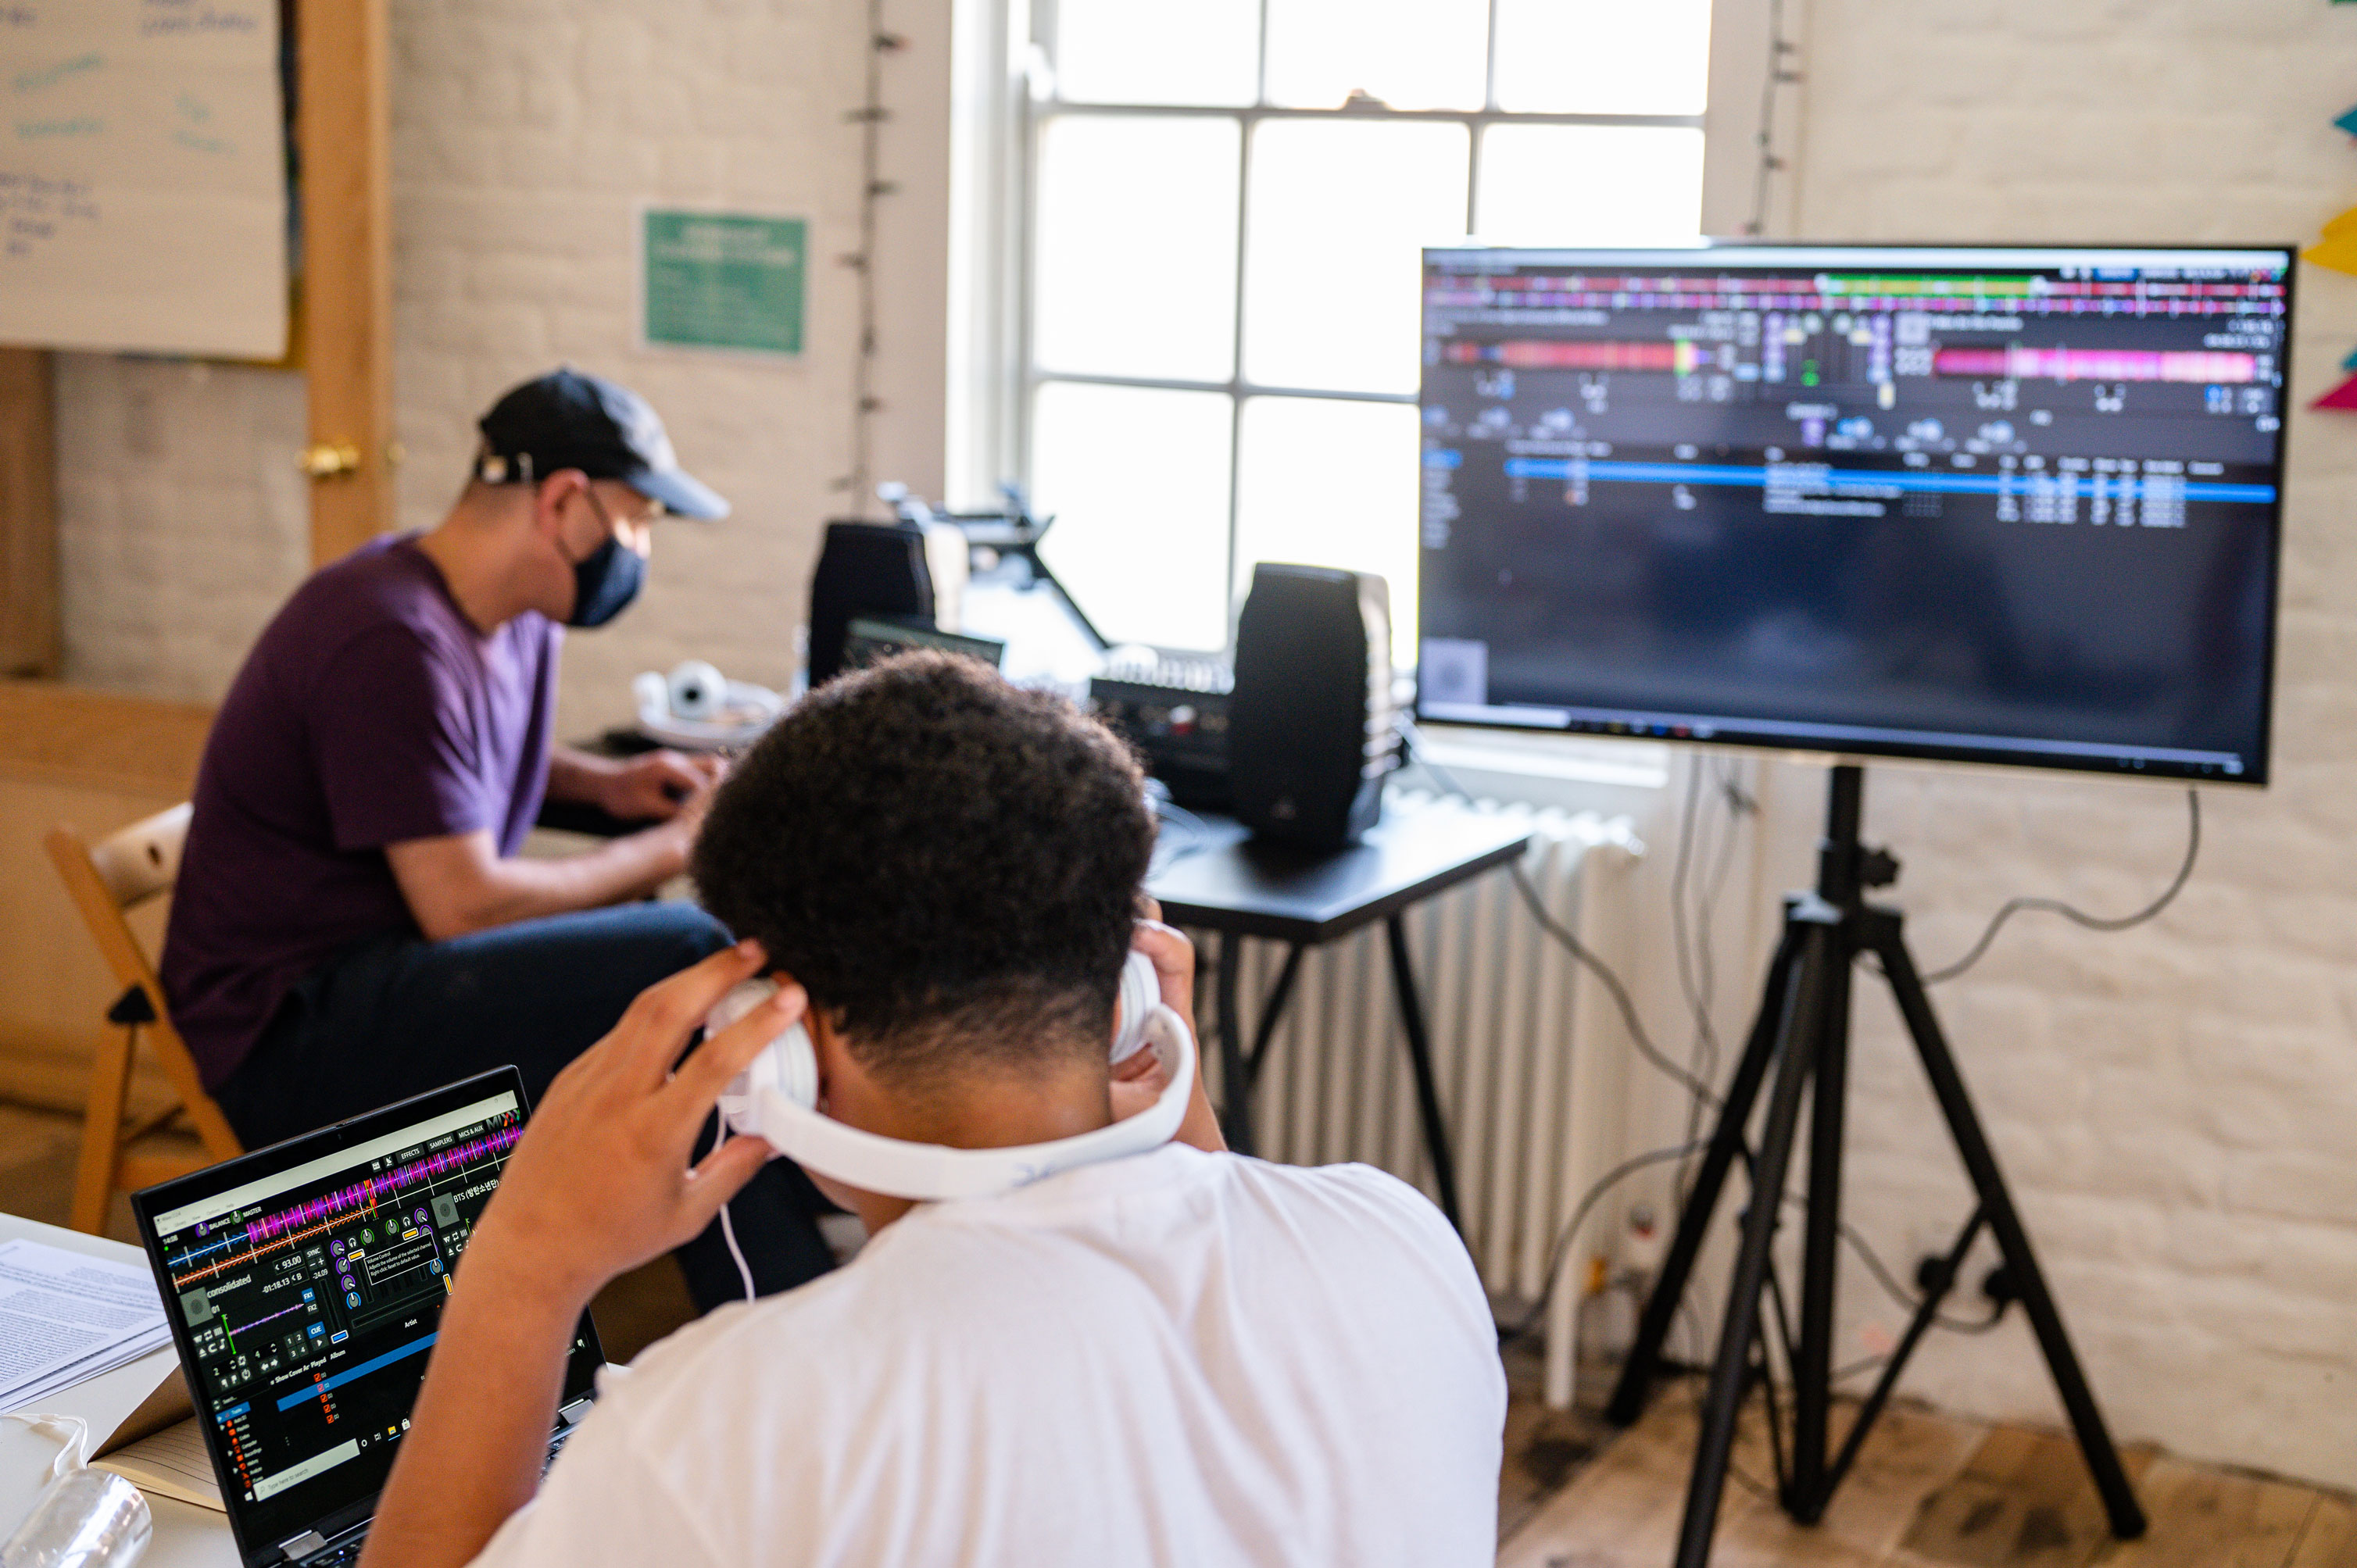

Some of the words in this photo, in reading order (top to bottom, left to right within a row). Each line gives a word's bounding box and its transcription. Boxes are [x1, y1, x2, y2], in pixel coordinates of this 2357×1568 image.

[458, 1129, 470, 1138] MICS
[474, 1124, 484, 1133] AUX
[430, 1136, 452, 1149] SAMPLERS
[401, 1148, 420, 1159] EFFECTS
[453, 1192, 466, 1203] BTS
[242, 1206, 263, 1217] MASTER
[209, 1217, 231, 1230] BALANCE
[306, 1247, 321, 1258] SYNC
[281, 1255, 302, 1270] 93.00
[313, 1269, 328, 1280] -24.09
[206, 1273, 252, 1298] consolidated
[263, 1277, 290, 1294] -01:18.13
[303, 1291, 313, 1300] FX1
[211, 1305, 220, 1314] 01
[307, 1304, 317, 1313] FX2
[405, 1319, 417, 1328] Artist
[311, 1326, 322, 1335] CUE
[330, 1350, 346, 1360] Album
[310, 1356, 327, 1369] Played
[213, 1367, 220, 1376] 2
